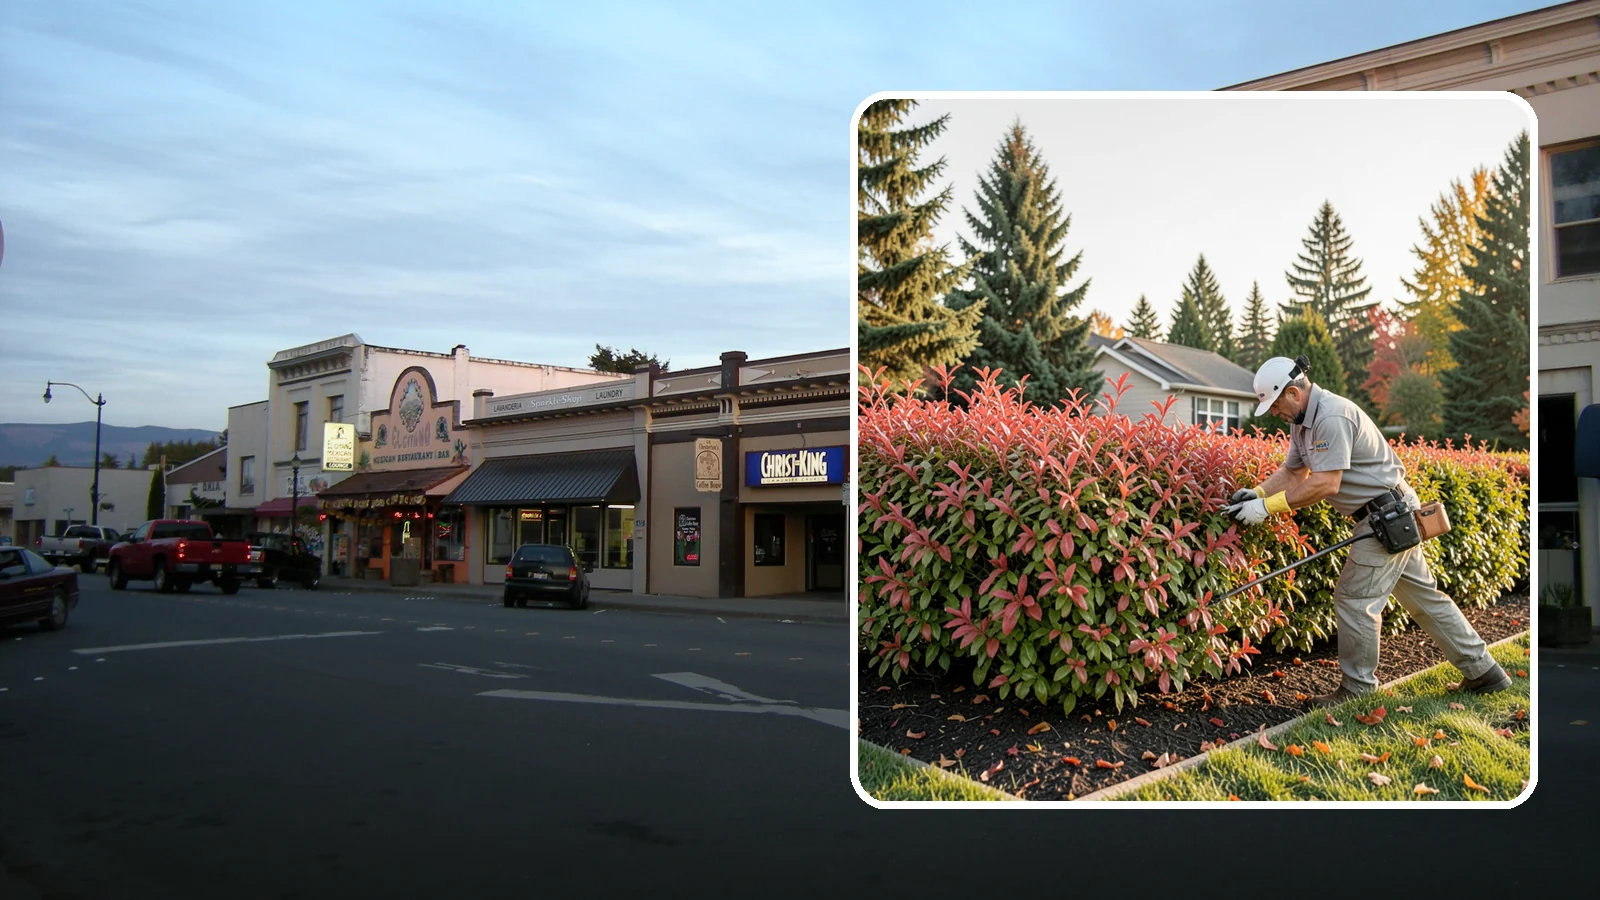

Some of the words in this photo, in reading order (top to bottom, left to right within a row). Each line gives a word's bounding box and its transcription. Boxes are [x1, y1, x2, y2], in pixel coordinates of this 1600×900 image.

[561, 394, 583, 406] Shop
[595, 389, 624, 401] LAUNDRY
[493, 402, 522, 412] LAVANDERIA
[373, 454, 396, 464] MEXICAN
[397, 451, 434, 462] RESTAURANT
[437, 450, 450, 459] BAR
[760, 452, 797, 478] CHRIST
[798, 450, 828, 476] KING
